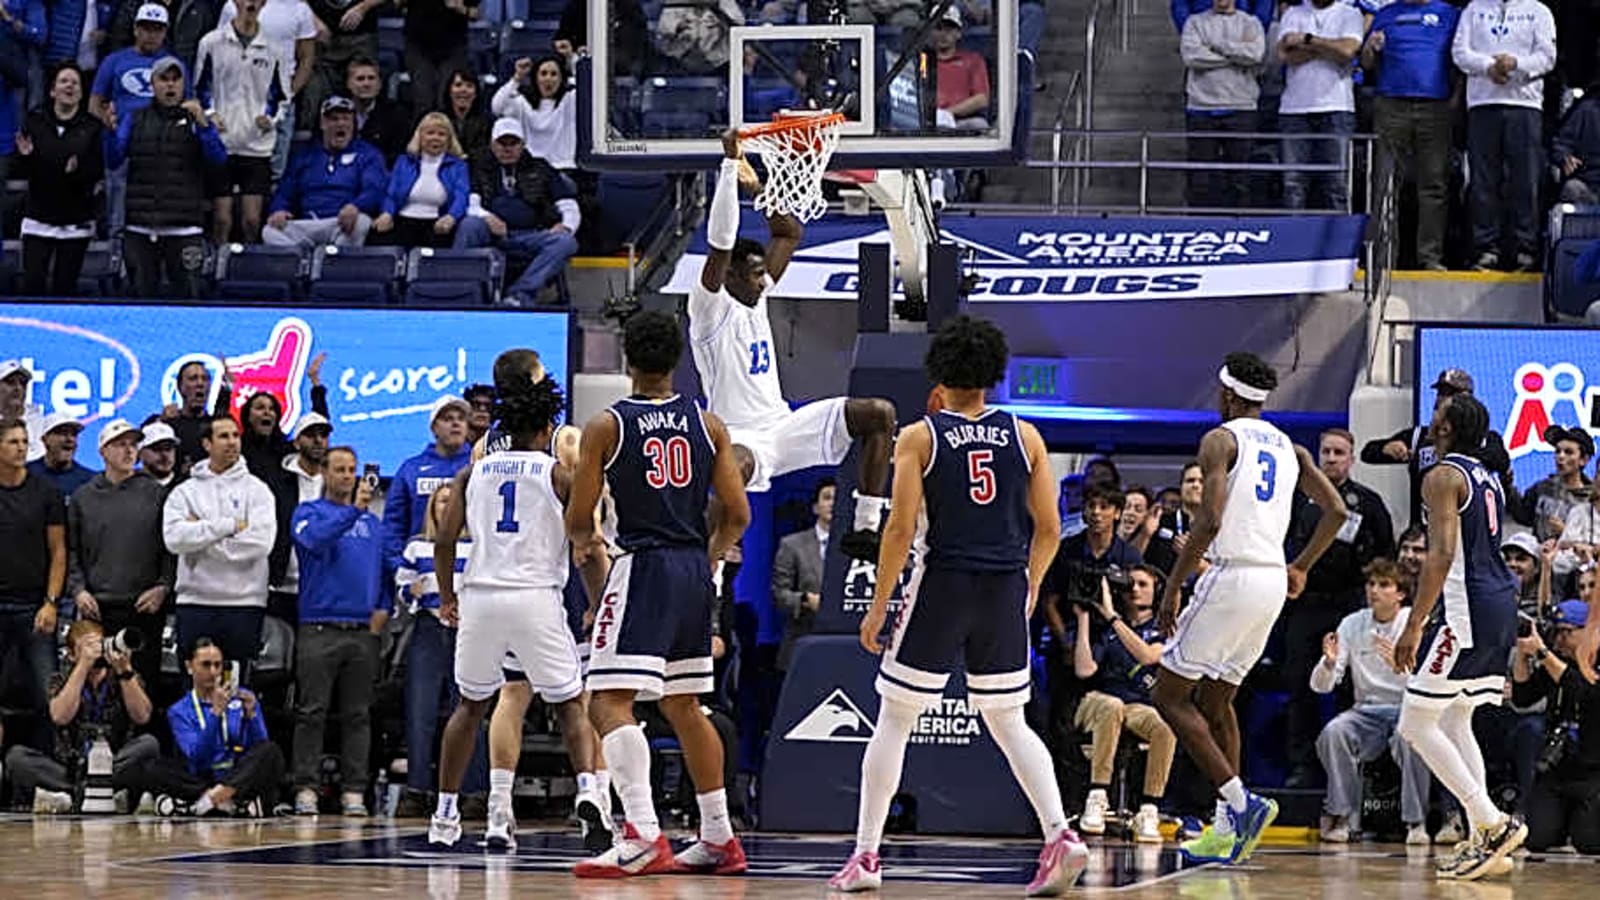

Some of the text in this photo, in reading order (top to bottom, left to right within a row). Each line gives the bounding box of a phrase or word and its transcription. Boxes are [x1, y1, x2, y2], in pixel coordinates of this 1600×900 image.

[1018, 230, 1270, 245] MOUNTAIN
[1026, 243, 1249, 258] AMERICA
[339, 347, 467, 401] score!
[749, 340, 770, 375] 13
[637, 411, 689, 435] AWAKA
[944, 424, 1010, 449] BURRIES
[482, 460, 544, 475] WRIGHT III
[643, 435, 692, 489] 30
[967, 449, 997, 505] 5
[1256, 450, 1277, 502] 3
[496, 480, 519, 533] 1
[595, 592, 619, 649] CATS
[912, 717, 981, 736] ERICA
